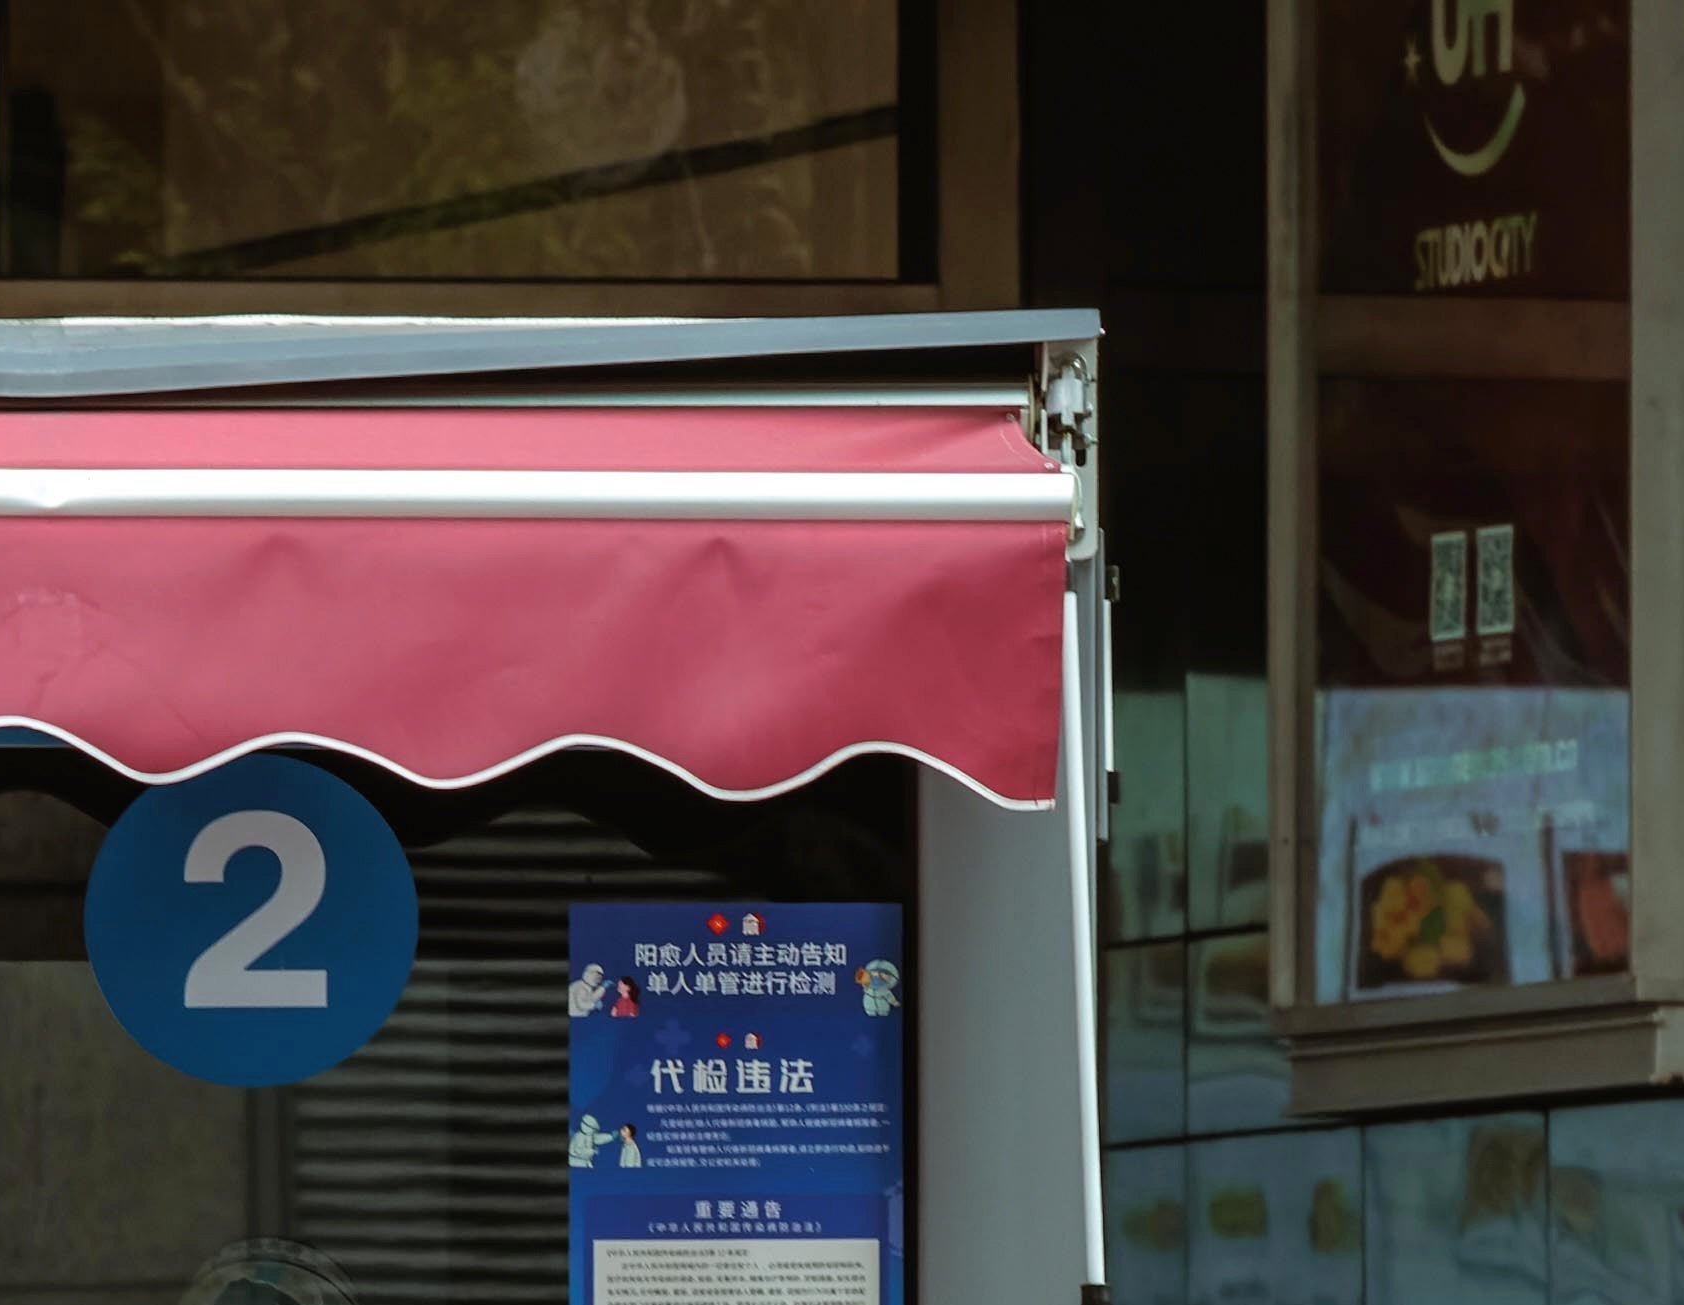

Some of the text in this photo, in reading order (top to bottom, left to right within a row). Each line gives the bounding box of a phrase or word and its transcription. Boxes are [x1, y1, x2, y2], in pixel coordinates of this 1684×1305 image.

[184, 809, 328, 1008] 2
[634, 942, 847, 966] 阳愈人员请主动告知
[646, 972, 836, 996] 单人单管进行检测
[650, 1058, 815, 1095] 代检违法
[694, 1200, 783, 1220] 重要通告
